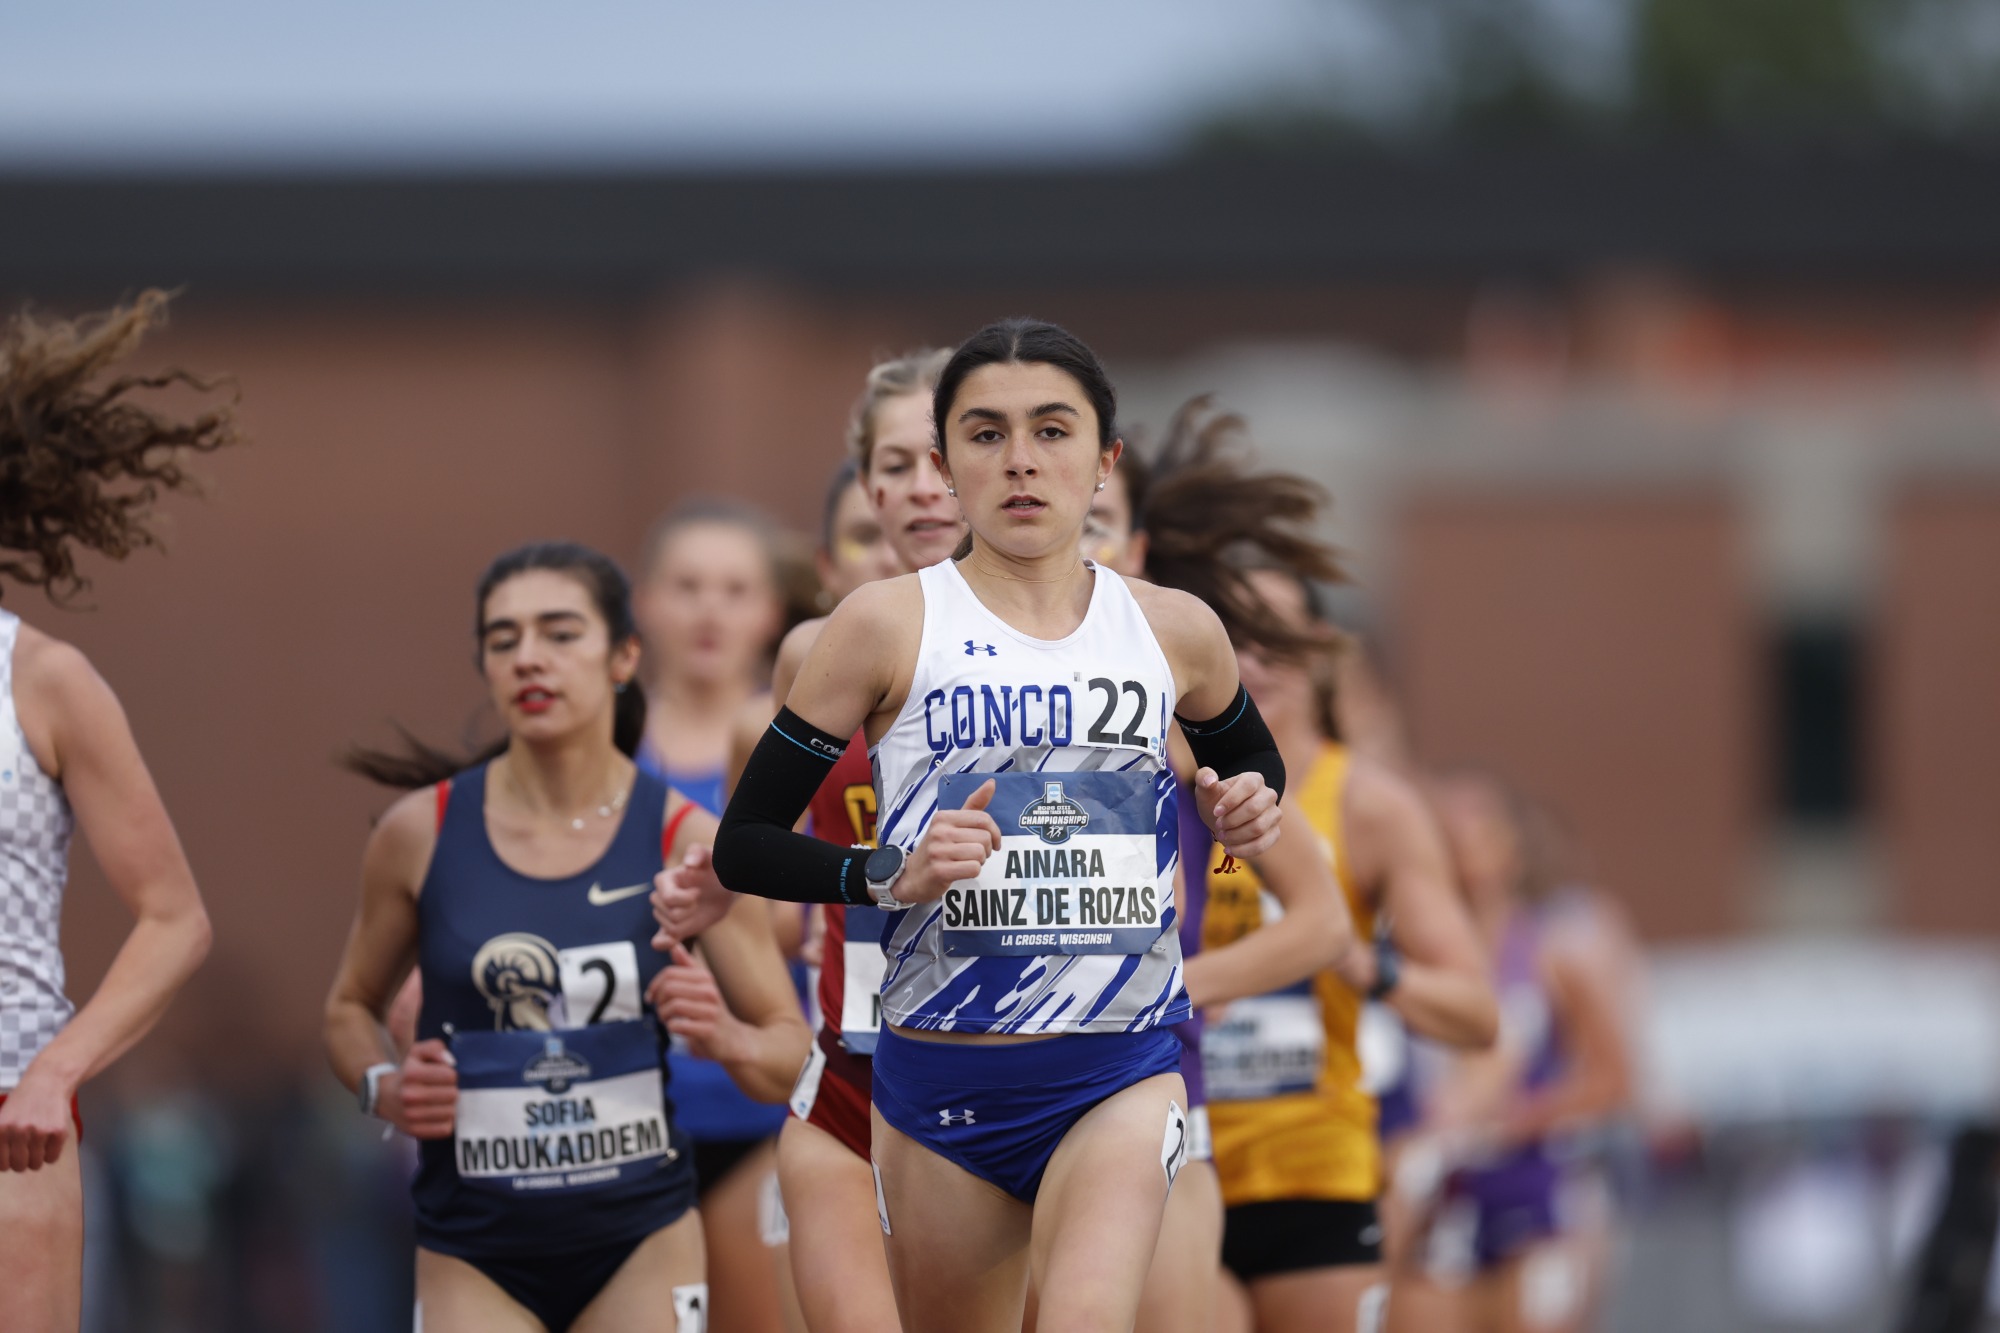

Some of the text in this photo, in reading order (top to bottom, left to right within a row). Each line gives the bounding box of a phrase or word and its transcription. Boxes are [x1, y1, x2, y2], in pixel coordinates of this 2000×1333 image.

[1087, 677, 1149, 749] 22
[1021, 815, 1087, 825] CHAMPIONSHIPS
[1004, 848, 1106, 879] AINARA
[945, 888, 1027, 927] SAINZ
[1036, 887, 1070, 925] DE
[1079, 886, 1157, 925] ROZAS
[1001, 933, 1112, 946] LA CROSSE, WISCONSIN
[581, 958, 616, 1024] 2
[524, 1097, 595, 1128] SOFIA
[461, 1119, 661, 1172] MOUKADDEM
